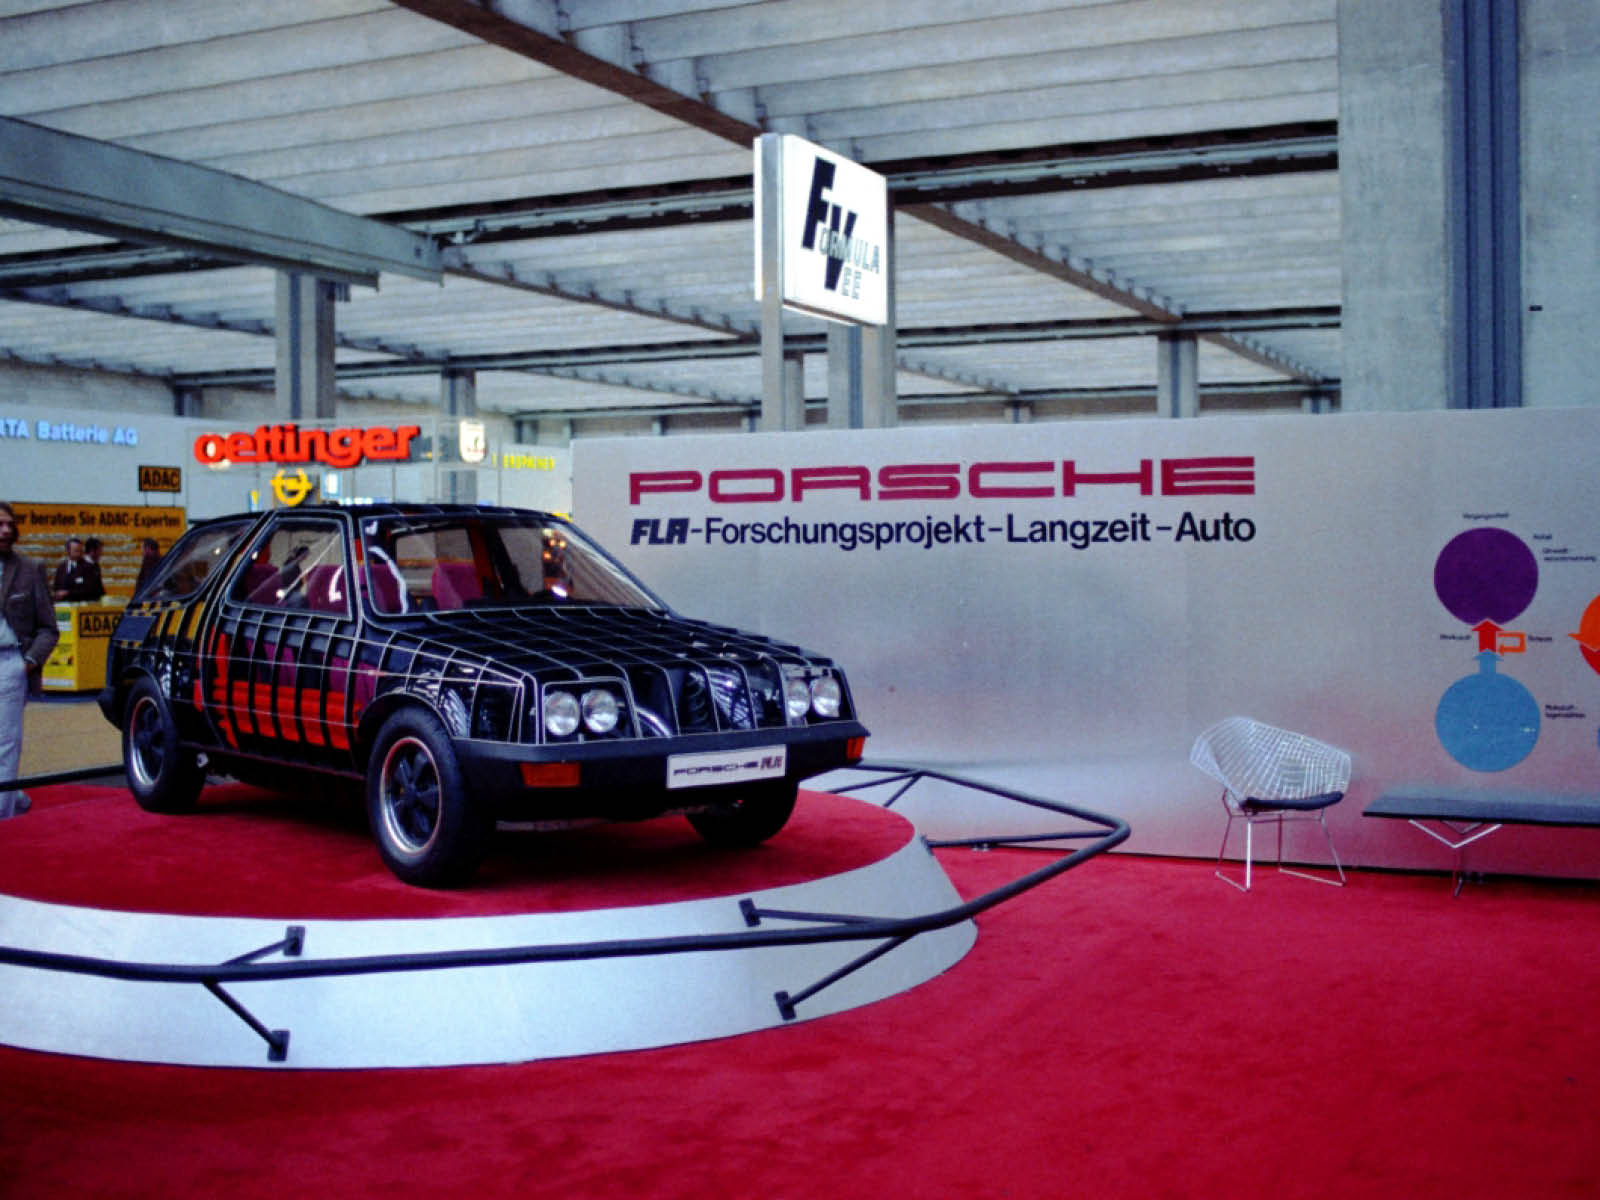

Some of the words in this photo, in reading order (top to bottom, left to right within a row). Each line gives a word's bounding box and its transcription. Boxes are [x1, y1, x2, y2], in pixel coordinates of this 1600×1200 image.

[36, 420, 108, 444] Batterie
[113, 426, 138, 446] AG
[193, 423, 420, 468] oettinger
[142, 470, 179, 489] ADAC
[629, 456, 1256, 505] PORSCHE
[31, 509, 76, 526] beraten
[79, 511, 97, 527] Sie
[100, 511, 181, 529] ADAC-Experten
[672, 760, 759, 776] PORSCHE
